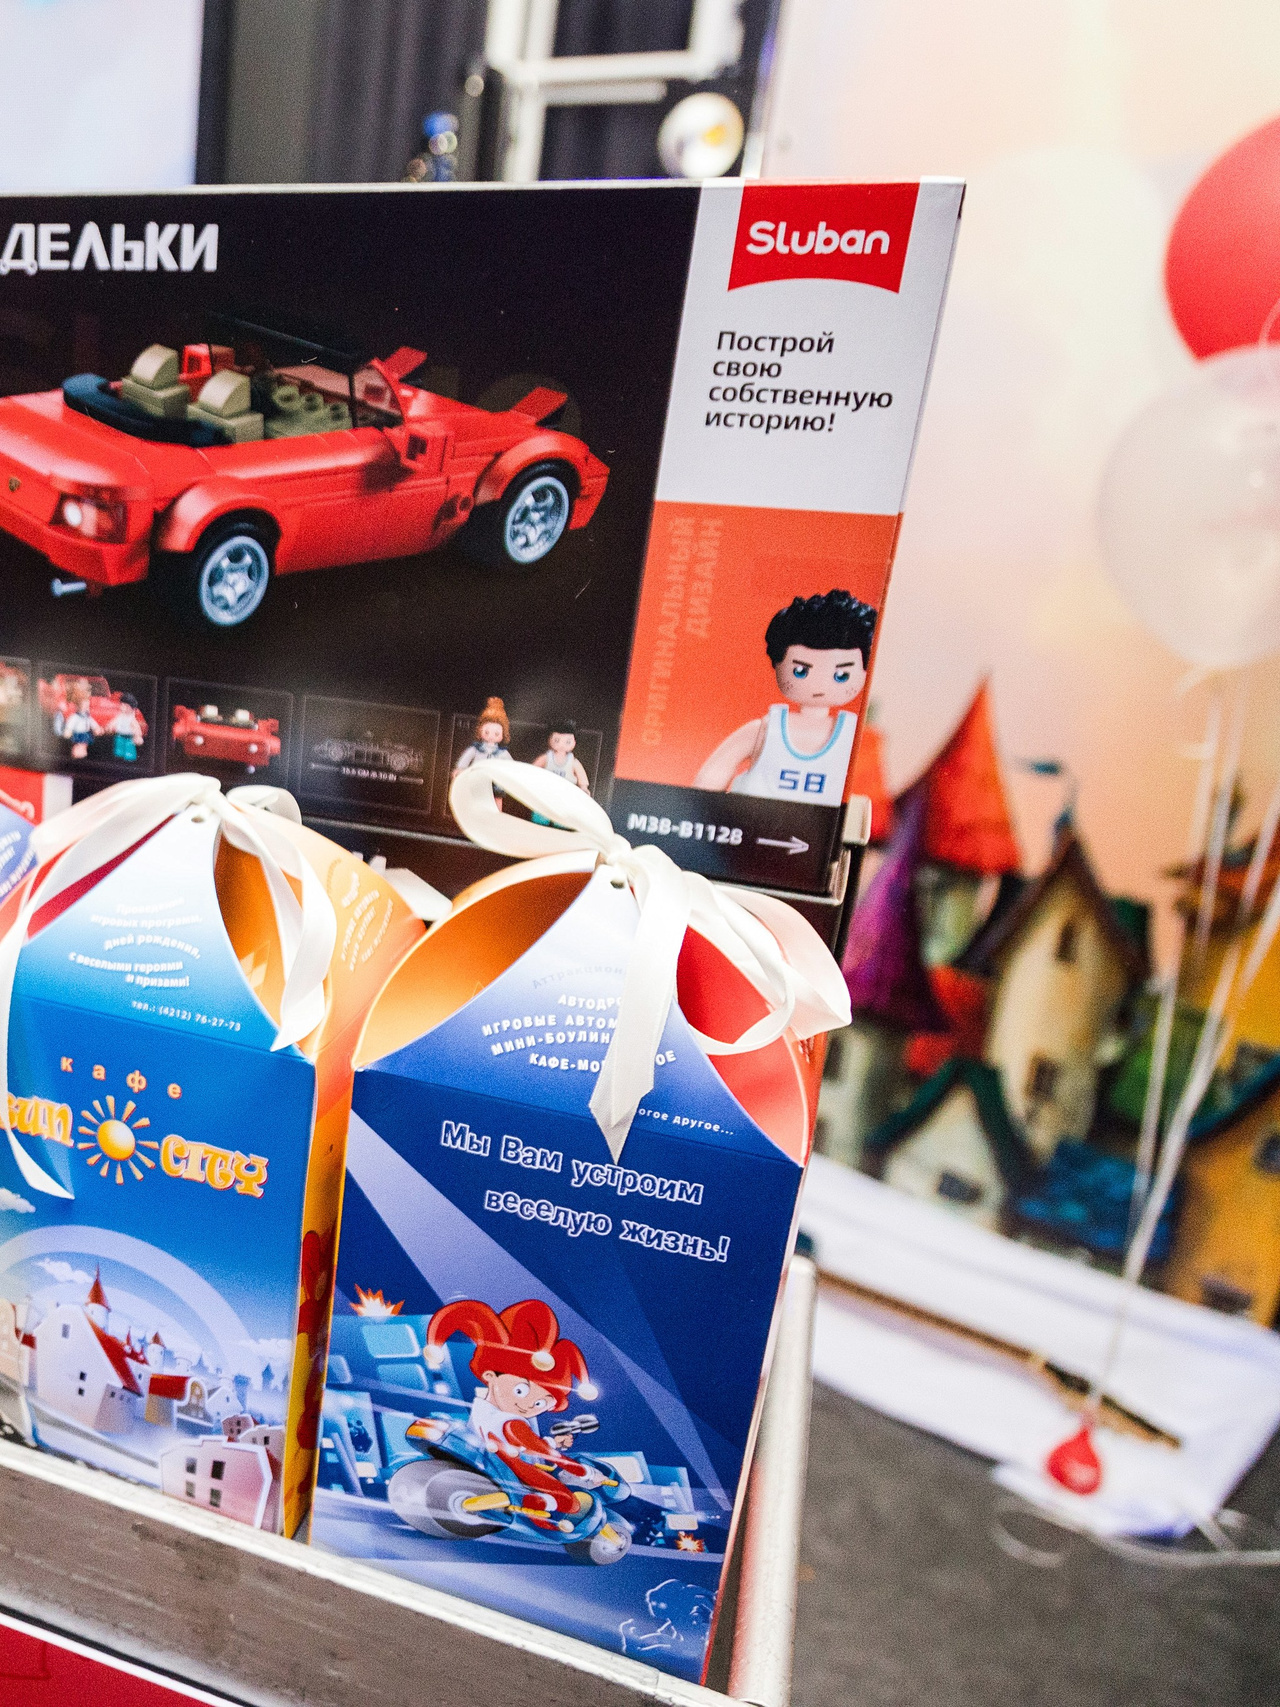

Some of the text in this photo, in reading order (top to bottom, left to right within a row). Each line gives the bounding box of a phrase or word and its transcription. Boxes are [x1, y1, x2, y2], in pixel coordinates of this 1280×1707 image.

[746, 220, 890, 255] Sluban
[716, 330, 835, 357] Построй
[711, 358, 783, 378] свою
[707, 382, 894, 411] собственную
[704, 410, 836, 435] историю!
[684, 518, 725, 640] ДИЗАЙН
[641, 516, 696, 747] ОРИГИНАЛЬНЫЙ
[778, 769, 827, 795] 58
[90, 914, 138, 928] игровых
[104, 933, 135, 951] дней
[77, 955, 132, 973] веселыми
[133, 961, 184, 975] героями
[531, 964, 626, 990] Аттракцион
[125, 974, 190, 989] и призами!
[158, 1006, 192, 1023] (4212)
[557, 994, 622, 1010] АВТОДР
[481, 1014, 619, 1037] ИГРОВЫЕ АВТОМ
[490, 1030, 610, 1057] МИНИ-БОУЛИН
[672, 1113, 735, 1136] другое...
[441, 1120, 704, 1205] Мы Вам устроим
[484, 1188, 731, 1264] веселую жизнь!
